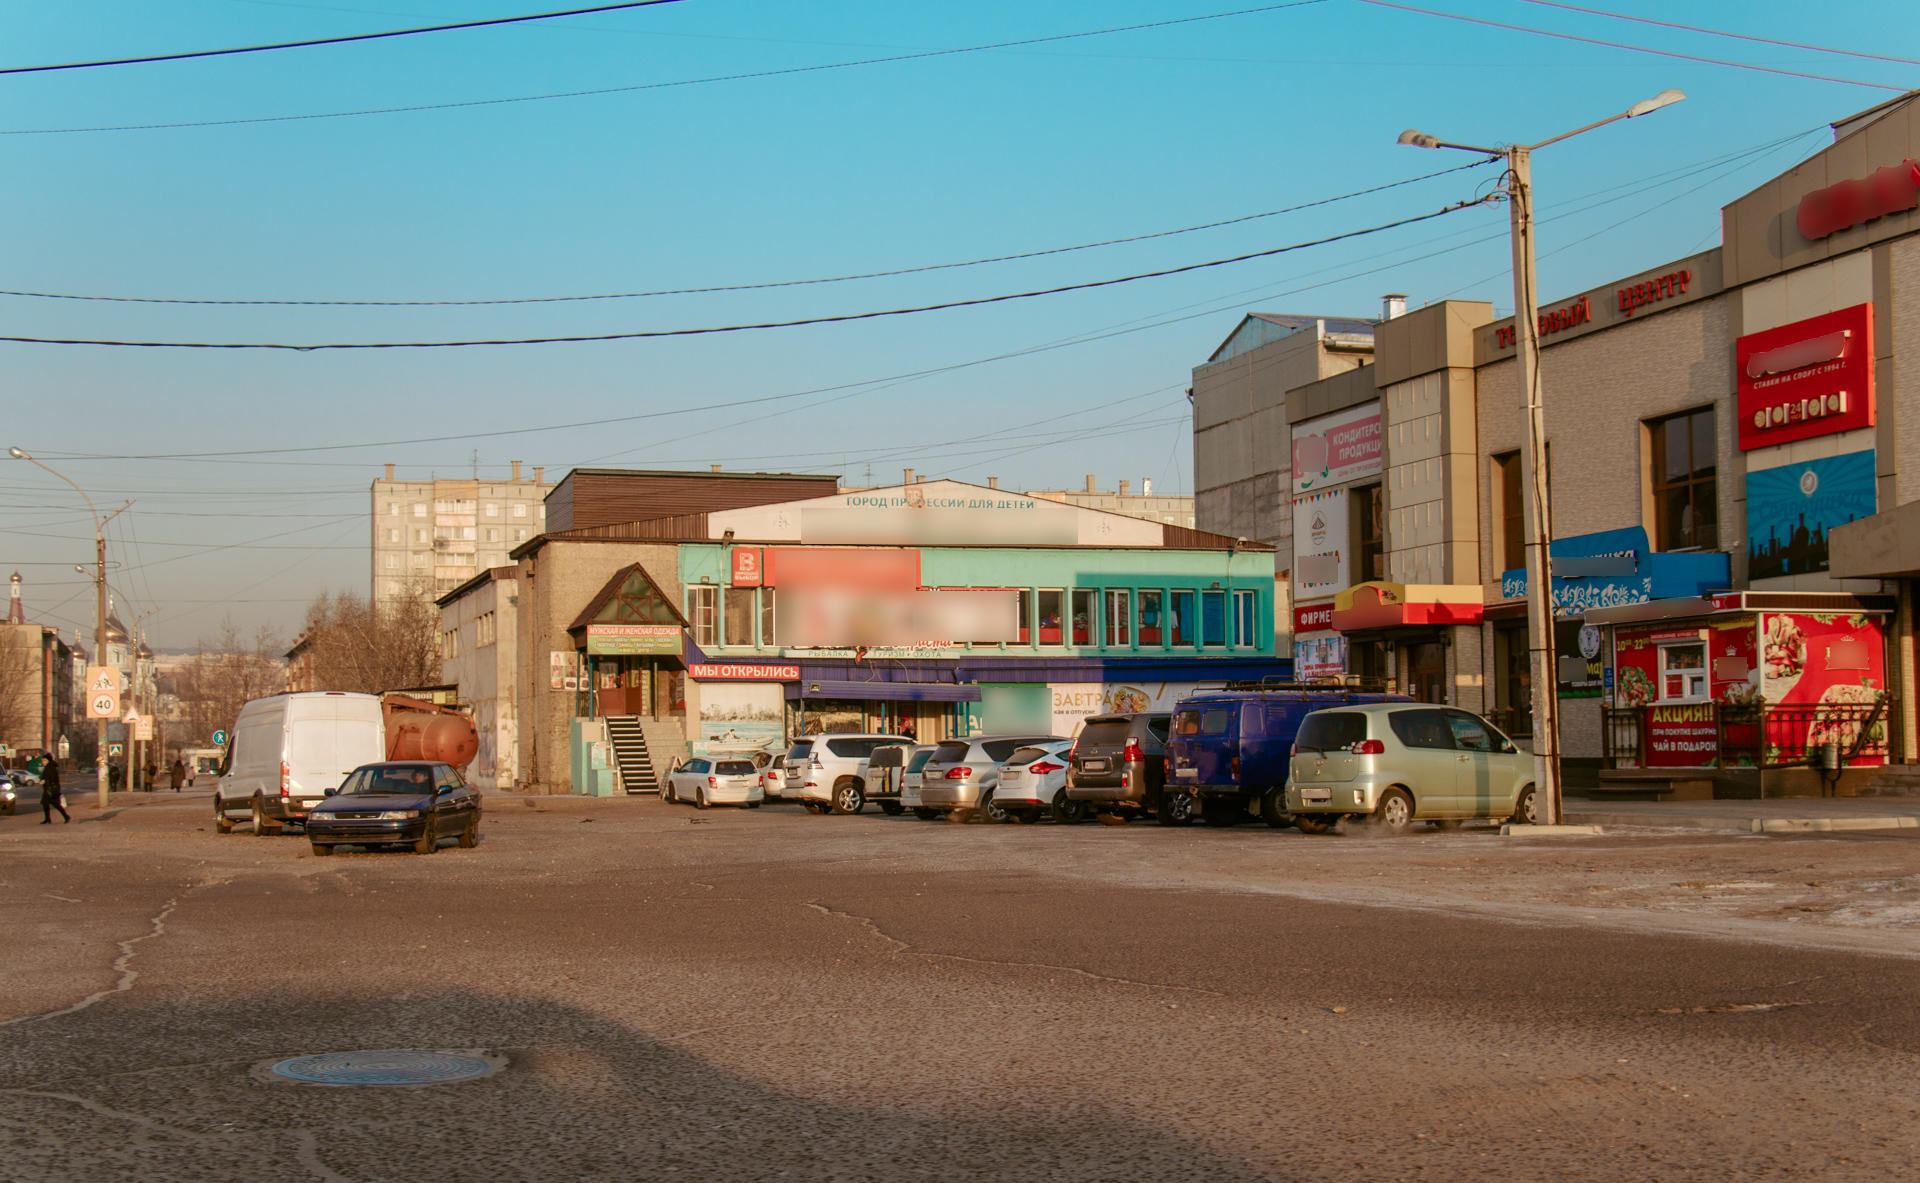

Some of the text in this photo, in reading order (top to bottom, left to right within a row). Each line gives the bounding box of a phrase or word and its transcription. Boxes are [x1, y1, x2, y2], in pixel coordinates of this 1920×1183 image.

[1495, 269, 1691, 349] ТООВЫЙ ЦЕНТР
[1753, 378, 1780, 389] СТАВКИ
[1781, 374, 1792, 383] НА
[1793, 368, 1816, 380] СПОРТ
[1790, 402, 1801, 414] 24
[1333, 422, 1381, 446] КОНДИТЕРС
[846, 497, 888, 508] ГОРОД
[891, 497, 964, 508] ПРЕССИИ
[968, 498, 993, 509] ДЛЯ
[694, 665, 798, 678] МЫ ОТКРЫЛИСЬ
[96, 700, 111, 710] 40
[1652, 703, 1714, 724] АКЦИЯ!!
[1653, 739, 1717, 752] ЧАЙ В ПОДАРОК
